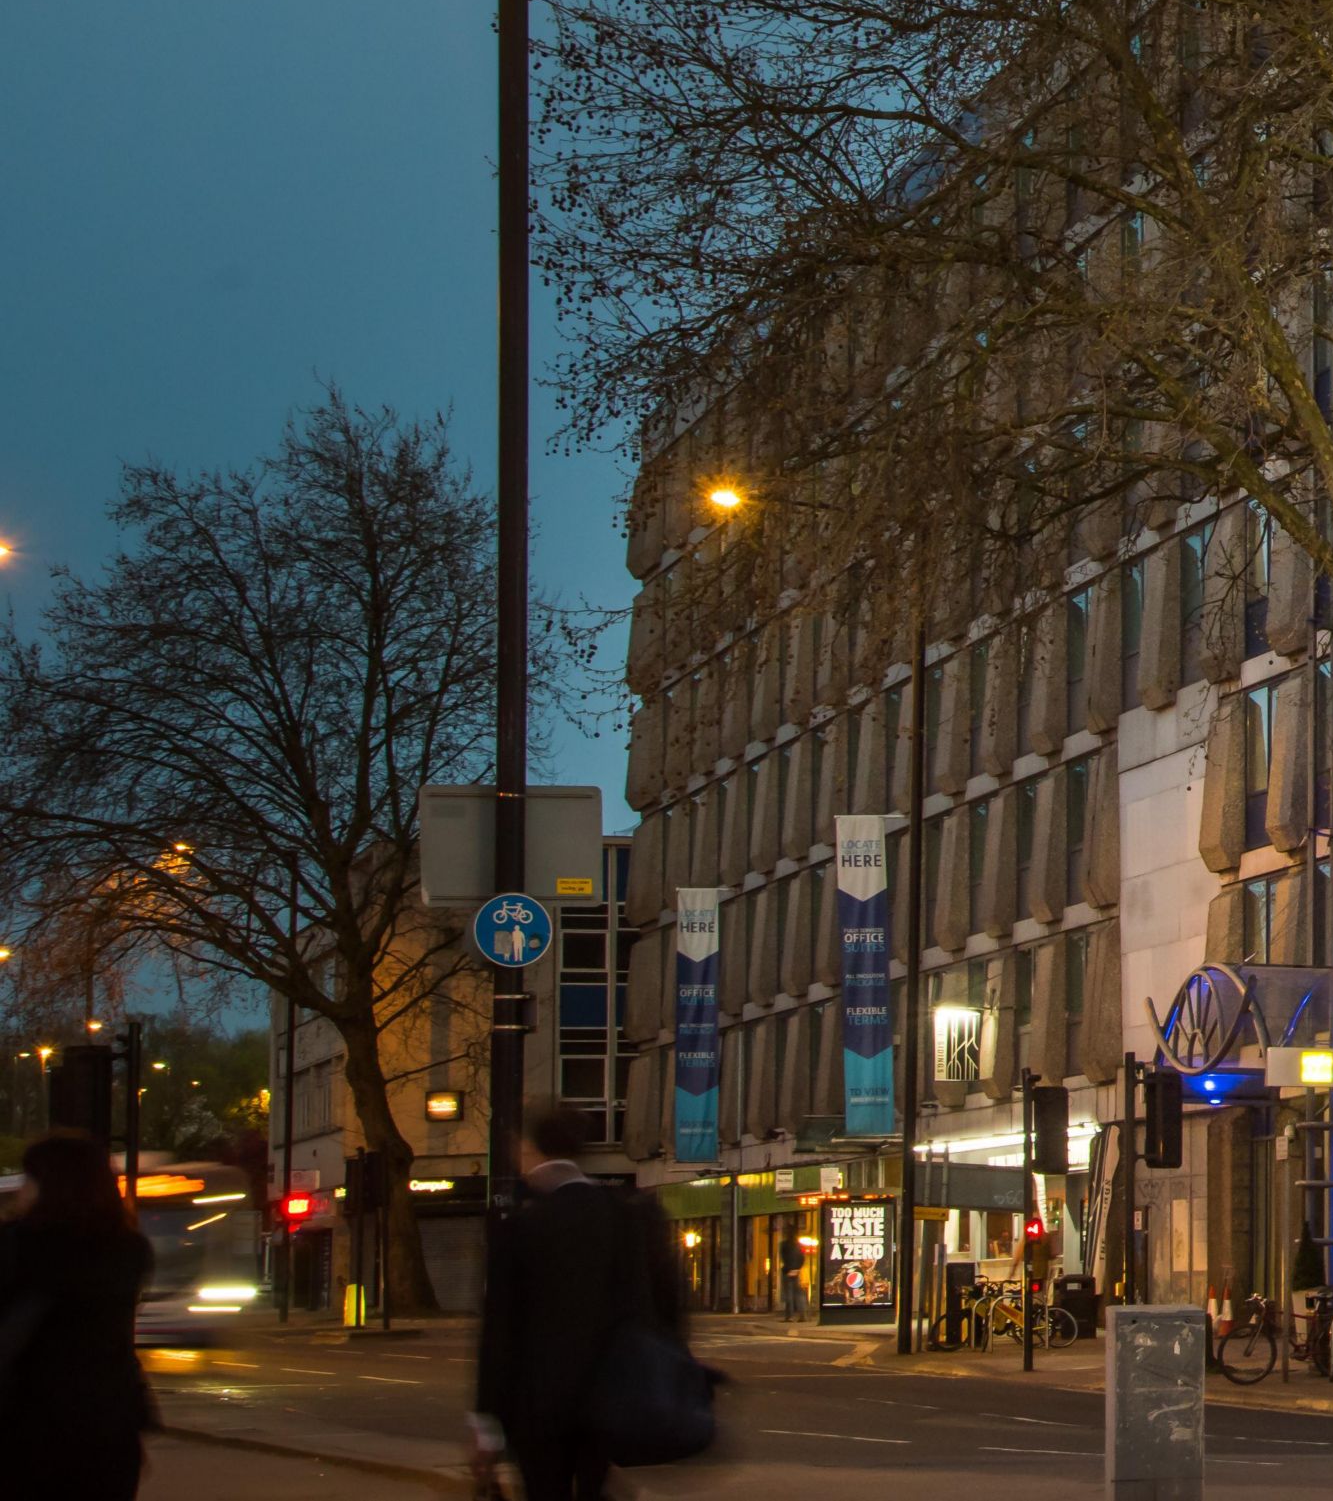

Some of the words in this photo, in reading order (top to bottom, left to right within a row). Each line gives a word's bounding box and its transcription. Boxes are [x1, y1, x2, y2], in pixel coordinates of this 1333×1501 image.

[841, 840, 881, 850] LOCATE
[841, 855, 882, 867] HERE
[680, 921, 715, 933] HERE
[844, 933, 885, 943] OFFICE
[680, 988, 715, 997] OFFICE
[847, 1006, 887, 1016] FLEXIBLE
[848, 1014, 889, 1025] TERMS
[410, 1179, 454, 1192] Computer
[831, 1207, 853, 1218] TOO
[853, 1207, 885, 1218] MUCH
[831, 1218, 884, 1237] TASTE
[831, 1244, 843, 1261] A
[844, 1244, 884, 1261] ZERO
